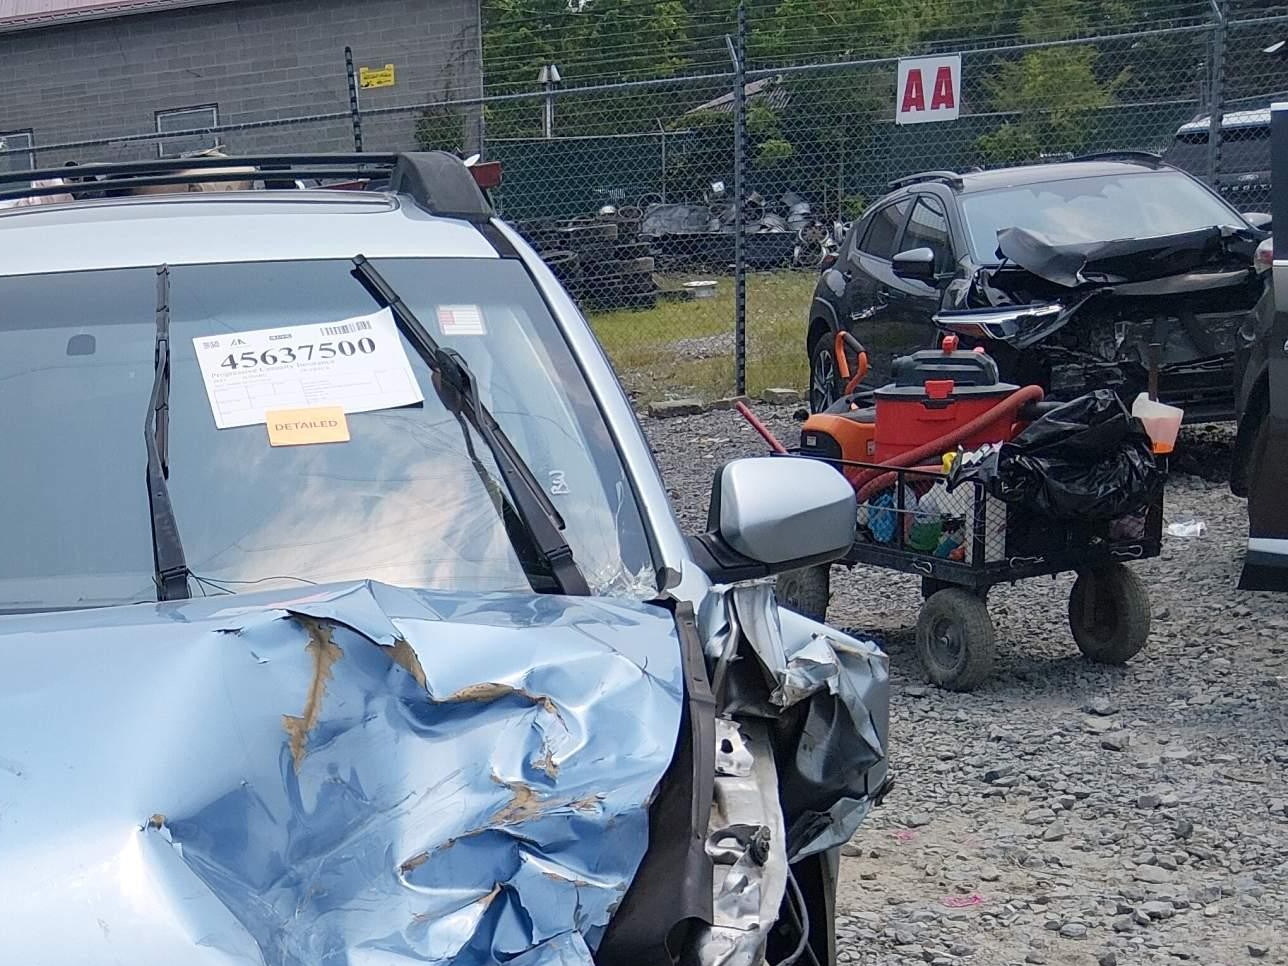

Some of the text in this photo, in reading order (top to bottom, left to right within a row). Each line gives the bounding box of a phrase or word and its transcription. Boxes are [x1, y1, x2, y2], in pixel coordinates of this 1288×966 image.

[901, 66, 955, 112] AA
[220, 337, 376, 370] 45637500
[275, 420, 338, 431] DETAILED
